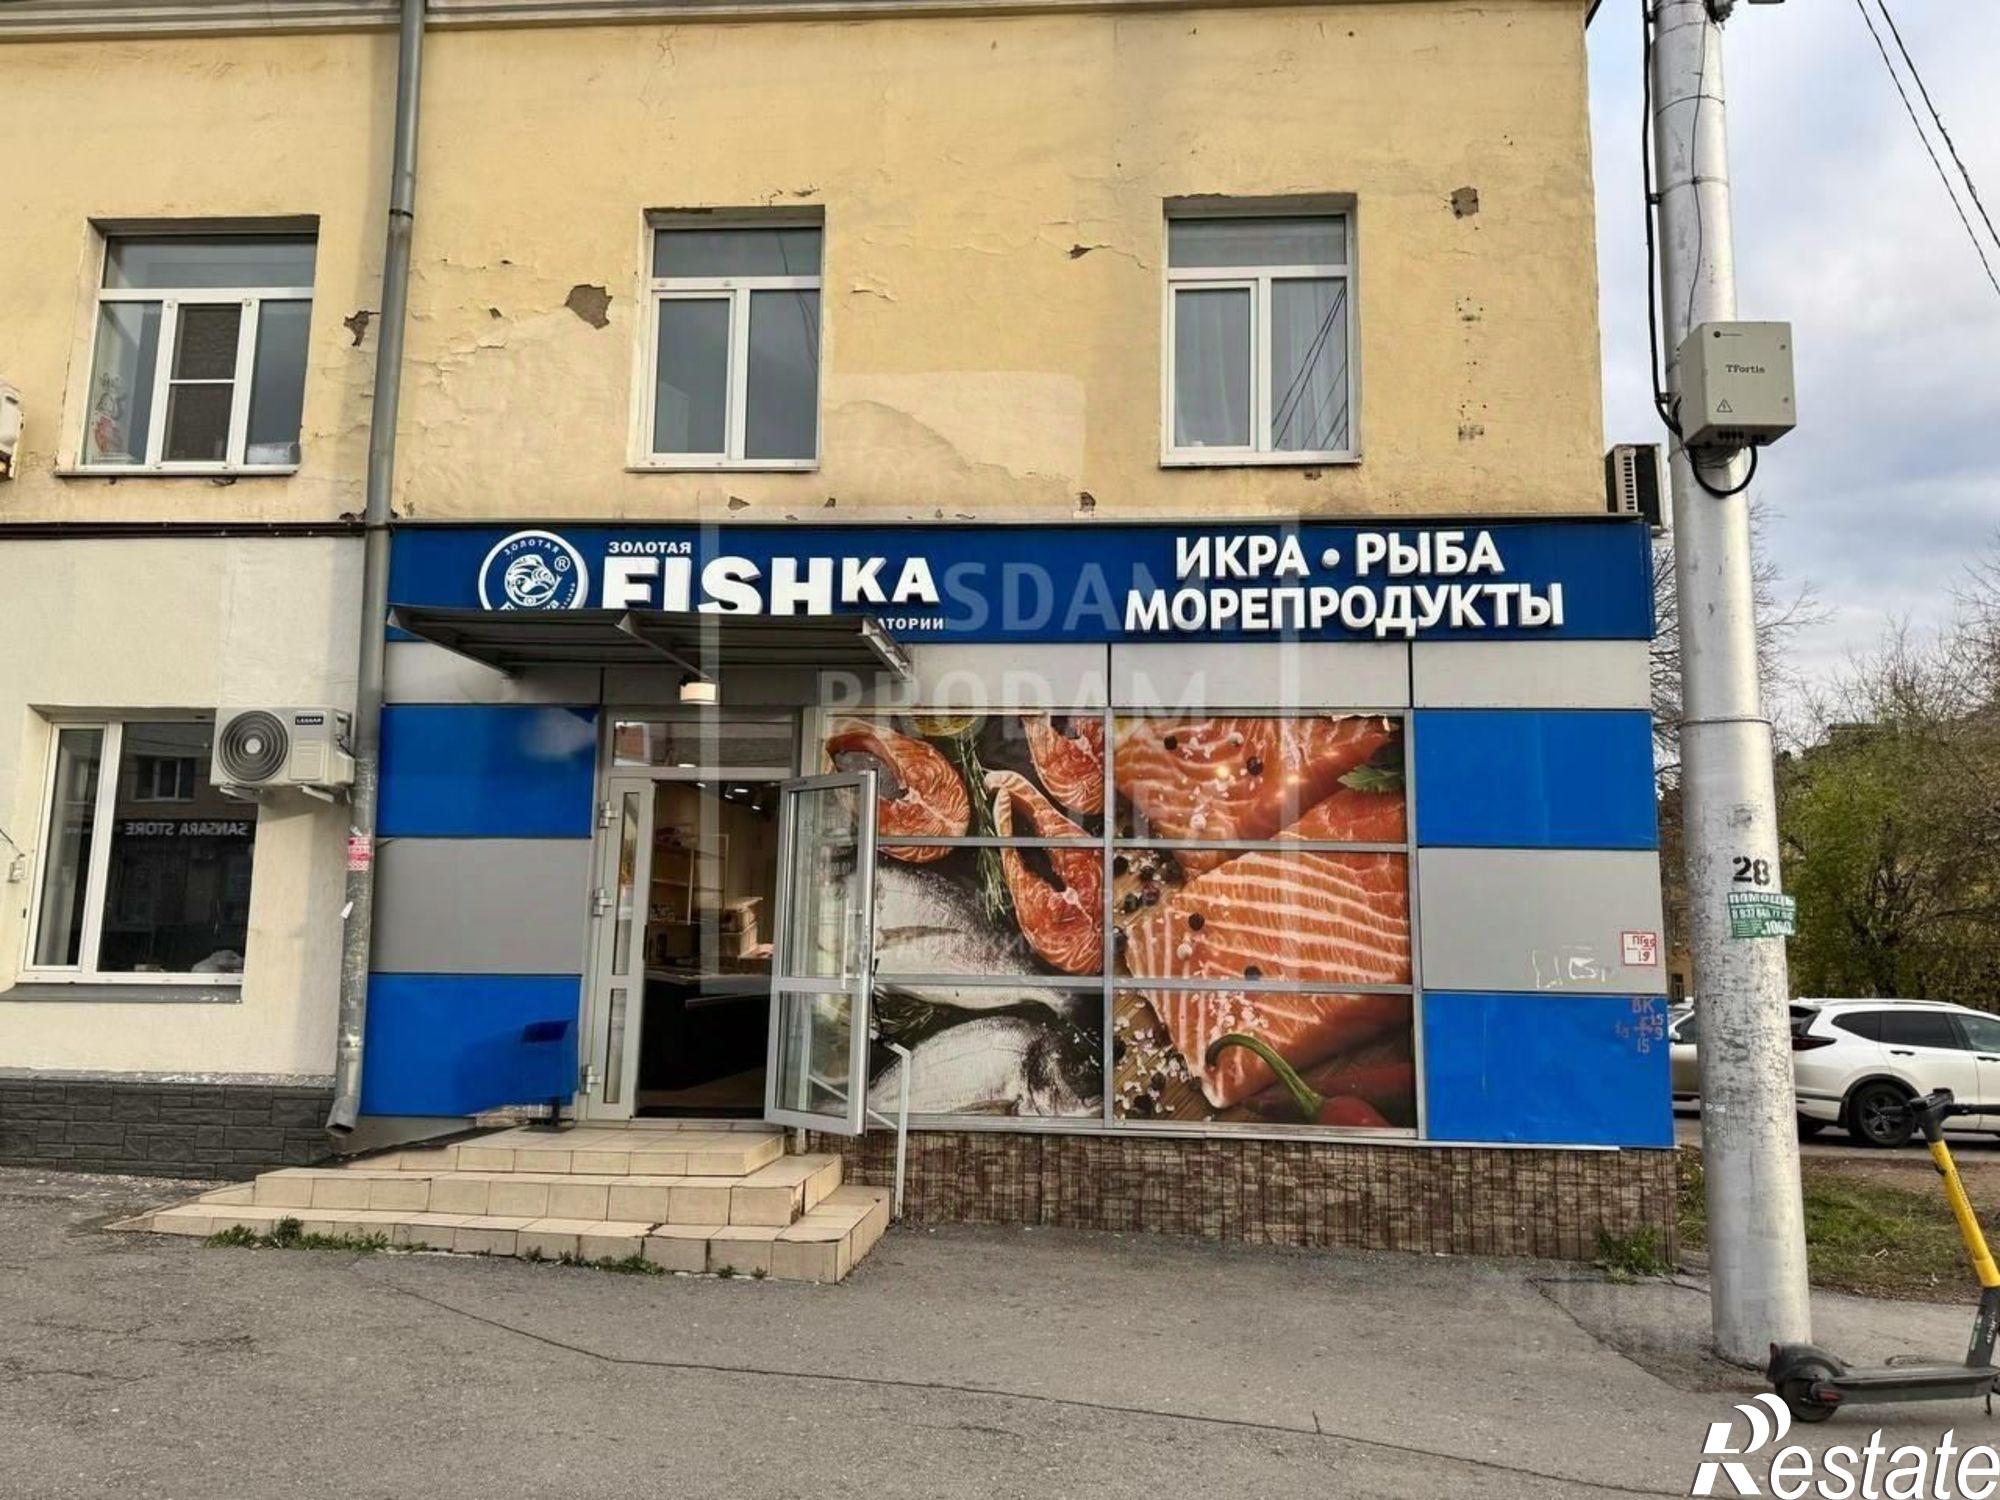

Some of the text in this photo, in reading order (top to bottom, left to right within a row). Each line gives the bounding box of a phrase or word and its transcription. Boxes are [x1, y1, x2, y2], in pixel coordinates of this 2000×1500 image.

[608, 541, 692, 554] ЗОЛОТАЯ
[1175, 530, 1505, 580] ИКРА РЫБА
[1124, 583, 1563, 637] МОРЕПРОДУКТЫ
[1733, 856, 1770, 886] 28
